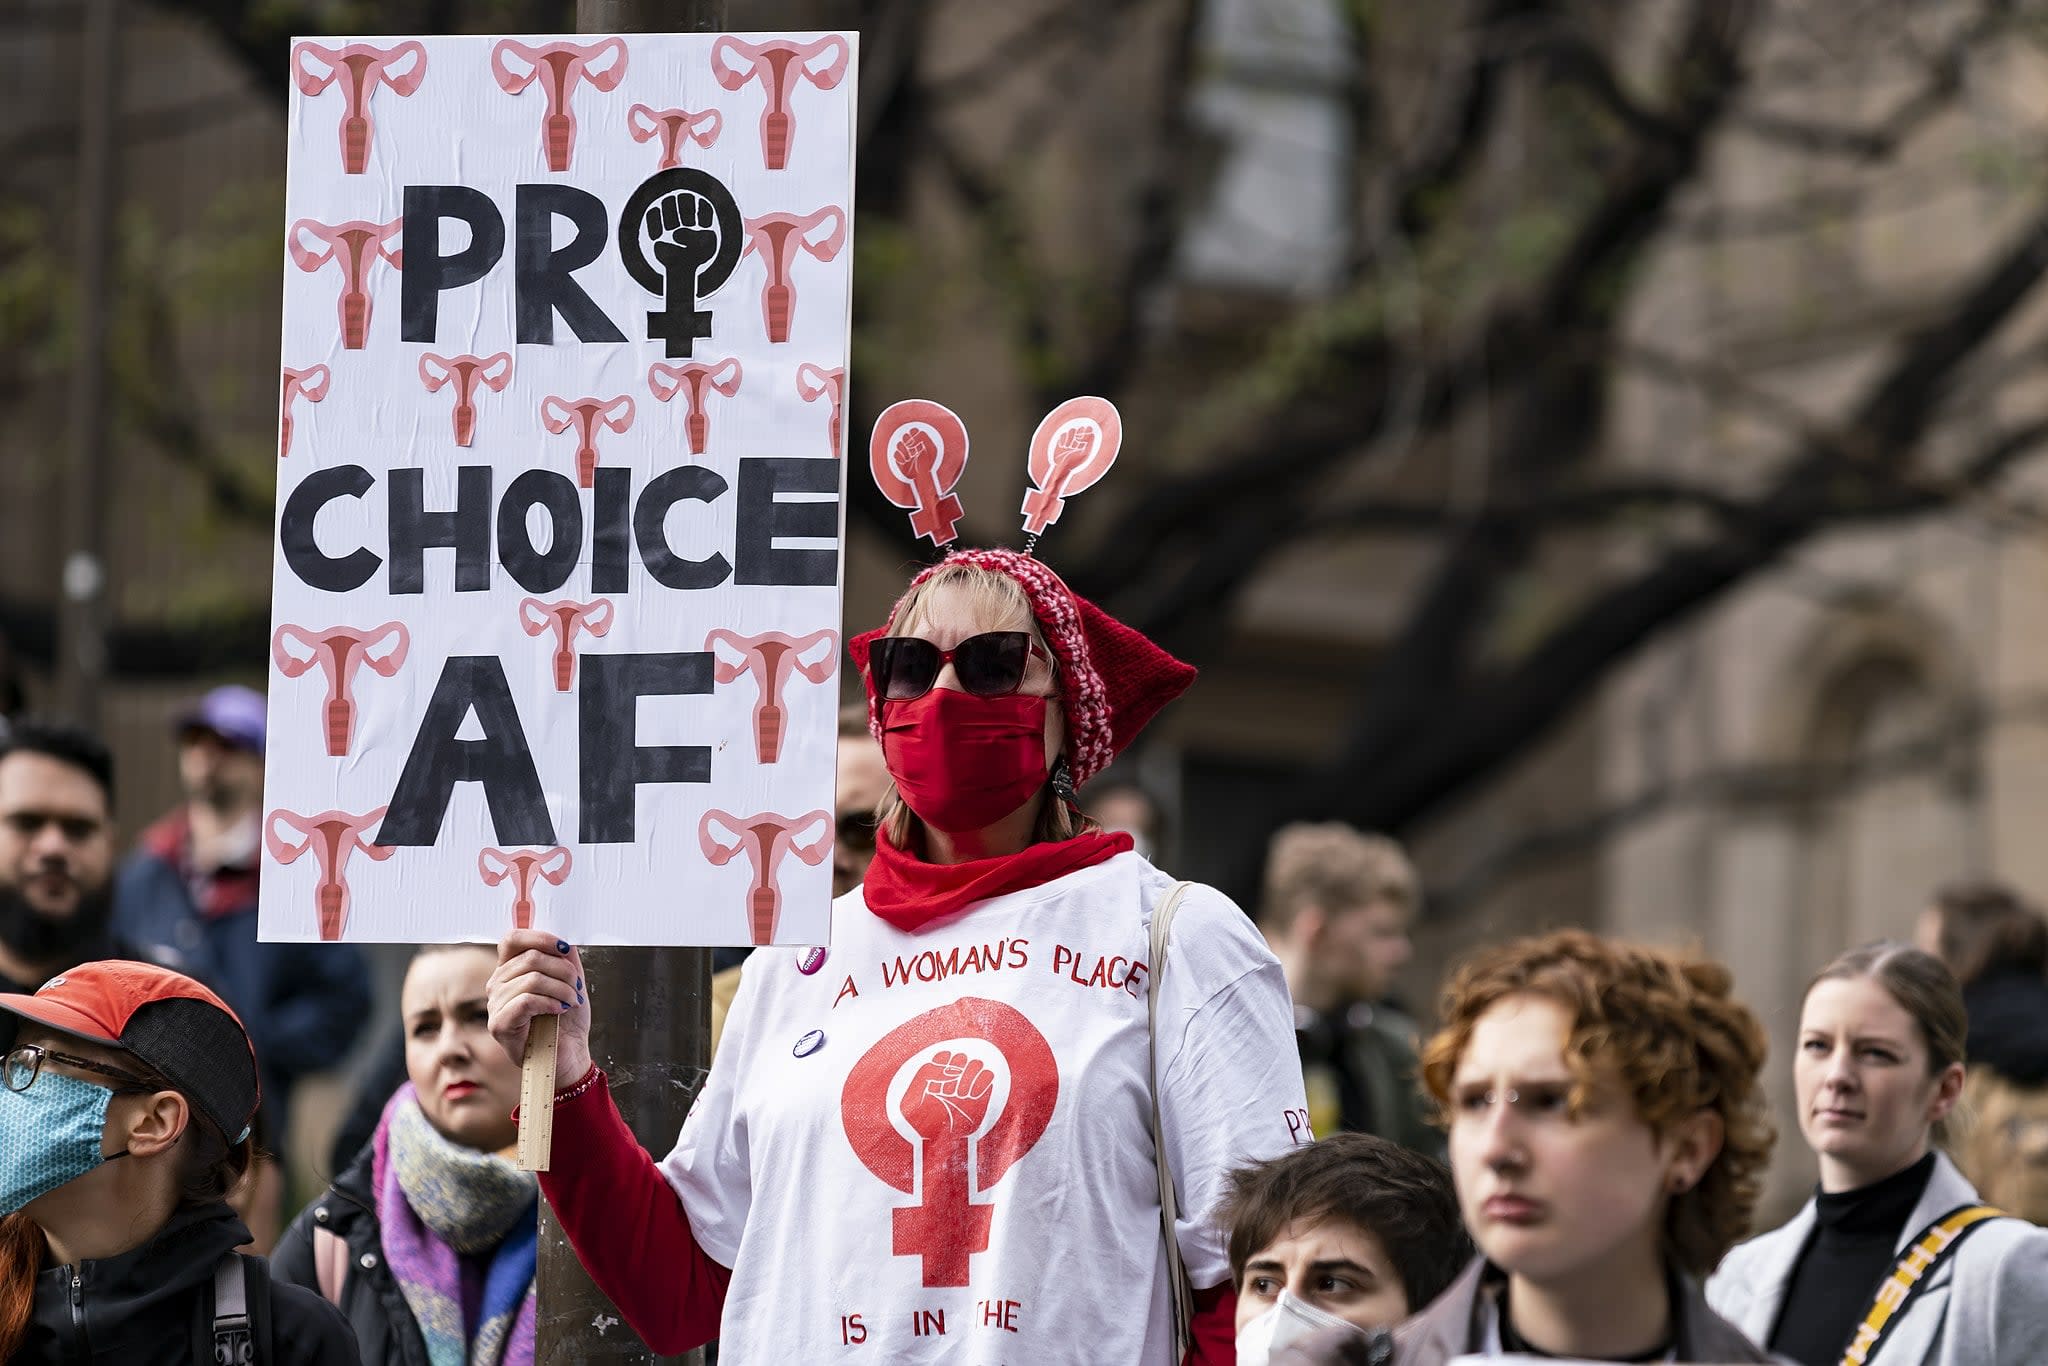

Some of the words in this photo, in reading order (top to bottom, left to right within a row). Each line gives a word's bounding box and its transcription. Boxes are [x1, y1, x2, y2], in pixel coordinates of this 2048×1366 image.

[281, 457, 840, 594] CHOICE
[373, 652, 715, 846] AF
[832, 974, 859, 1009] A
[881, 937, 1029, 988] WOMAN'S
[1053, 944, 1149, 998] PLACE
[1875, 1225, 1964, 1313] THE
[841, 1313, 868, 1346] IS
[913, 1308, 946, 1337] IN
